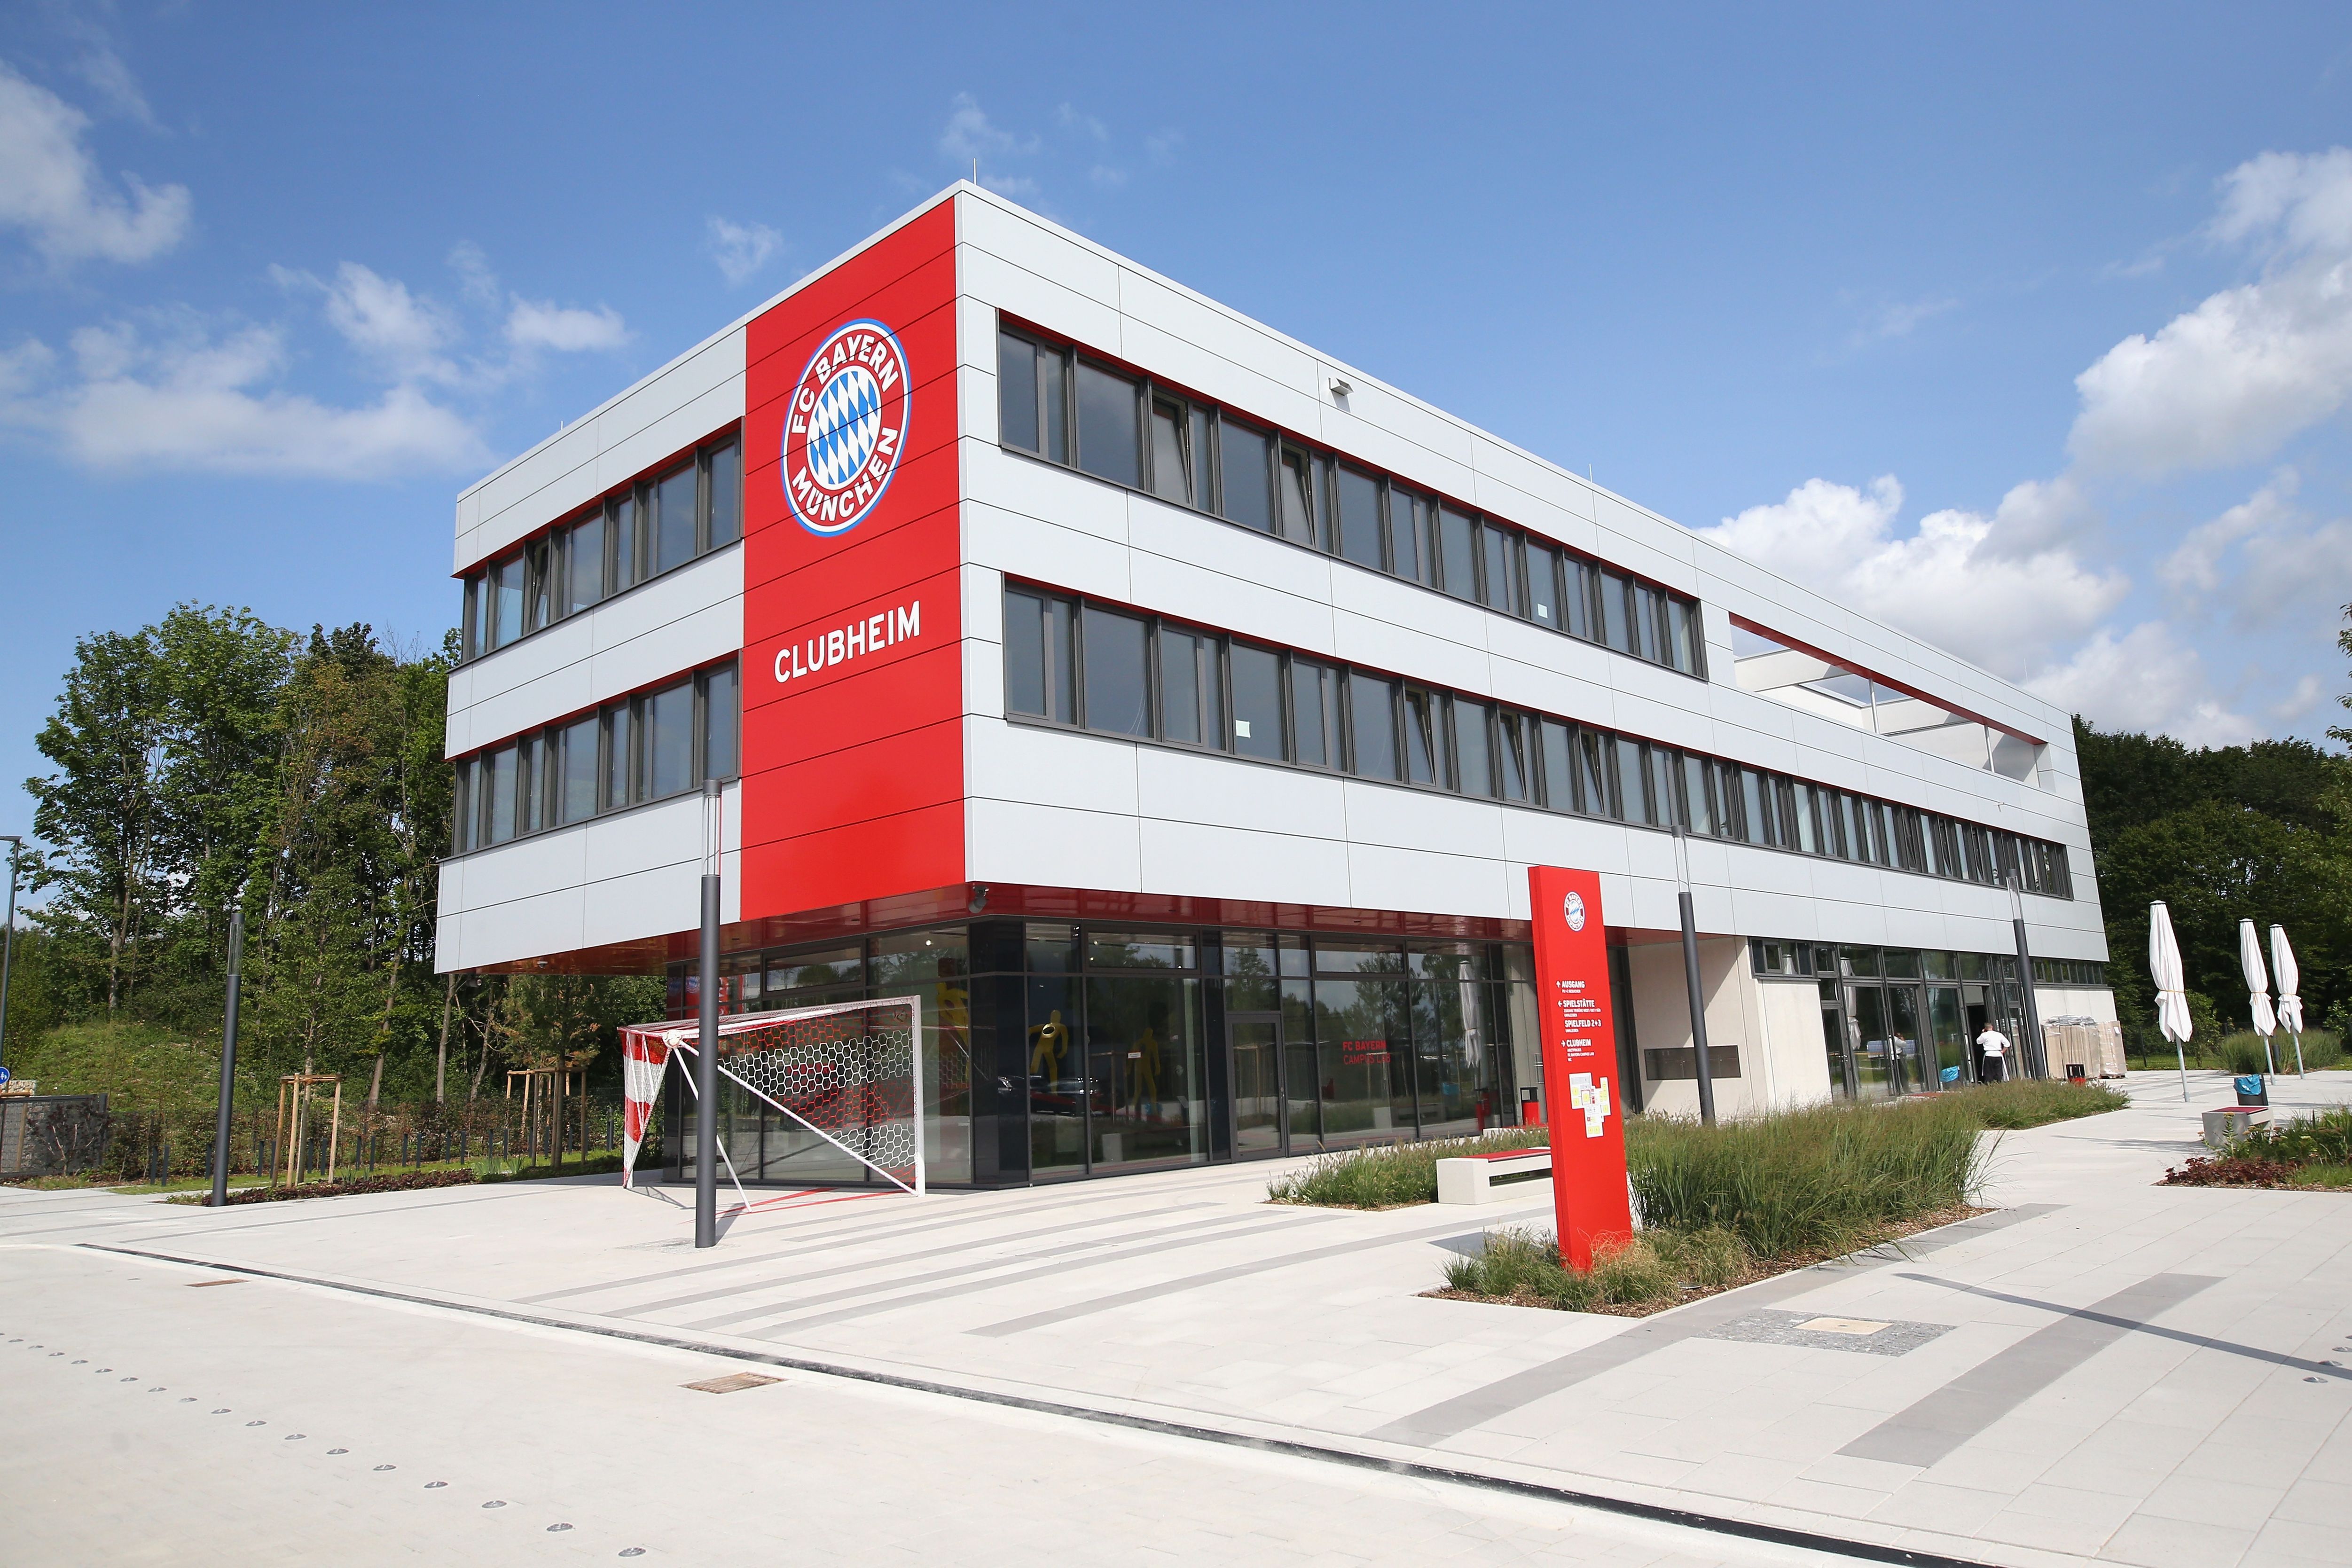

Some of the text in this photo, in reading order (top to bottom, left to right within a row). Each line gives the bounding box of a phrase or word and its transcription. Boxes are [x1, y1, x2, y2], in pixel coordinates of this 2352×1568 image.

[791, 334, 899, 433] FC BAYERN
[792, 427, 898, 522] MÜNCHEN
[774, 600, 920, 683] CLUBHEIM
[1561, 980, 1585, 988] AUSGANG
[1563, 998, 1595, 1007] SPIELSTÄTTE
[1342, 1040, 1386, 1051] FC BAYERN
[1566, 1039, 1592, 1047] CLUBHEIM
[1343, 1052, 1391, 1065] CAMPUS LAB
